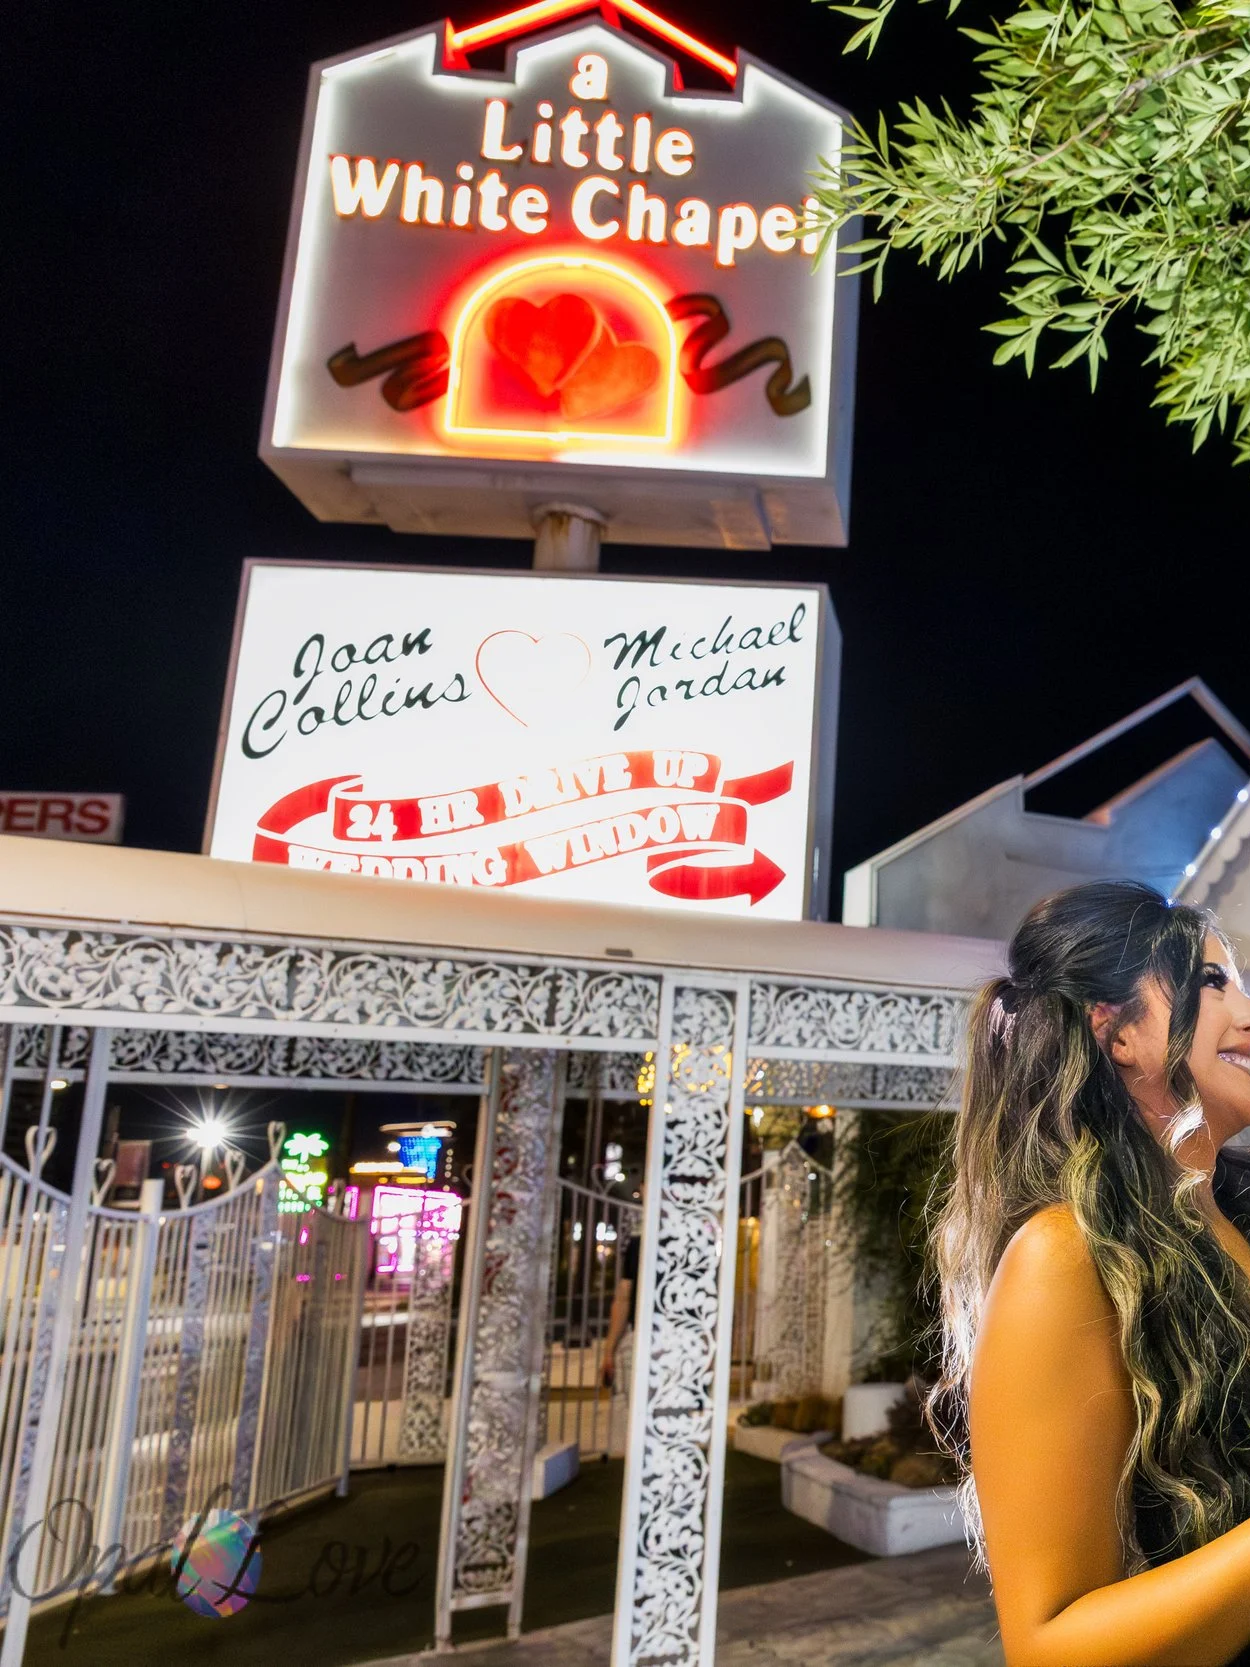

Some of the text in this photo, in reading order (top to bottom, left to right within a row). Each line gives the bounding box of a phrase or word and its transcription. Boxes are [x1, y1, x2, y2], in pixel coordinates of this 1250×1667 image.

[570, 53, 609, 100] a
[480, 99, 696, 176] Little
[330, 154, 821, 267] White Chapel
[293, 627, 433, 706] Joan
[603, 602, 806, 670] Michael
[241, 672, 473, 759] Collins
[613, 660, 787, 731] Jordan
[0, 797, 111, 835] ERS
[345, 803, 399, 843] 24
[417, 790, 485, 835] HR
[651, 750, 710, 789] UP
[523, 802, 721, 876] WINDOW
